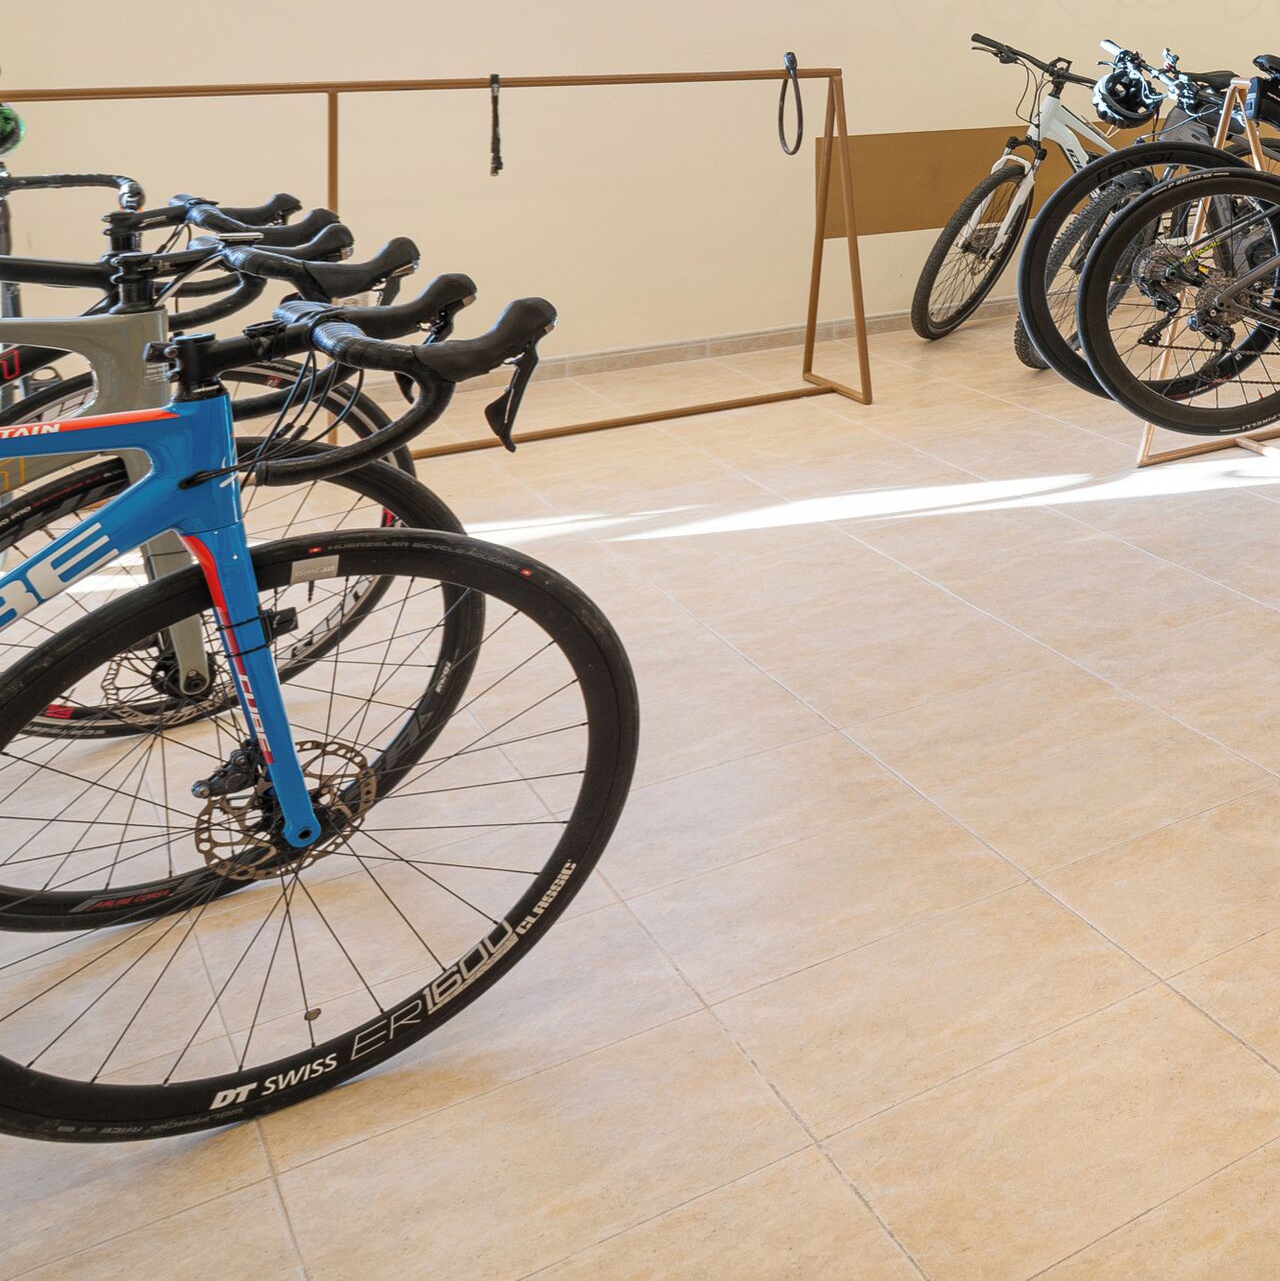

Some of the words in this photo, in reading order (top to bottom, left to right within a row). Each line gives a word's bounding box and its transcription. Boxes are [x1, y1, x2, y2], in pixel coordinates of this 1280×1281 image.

[328, 541, 412, 551] HUERZELER
[413, 542, 466, 556] BICYCLE
[237, 671, 273, 754] CUBE
[209, 1080, 258, 1111] DT
[260, 1052, 338, 1098] SWISS
[515, 858, 578, 936] CLASSIC
